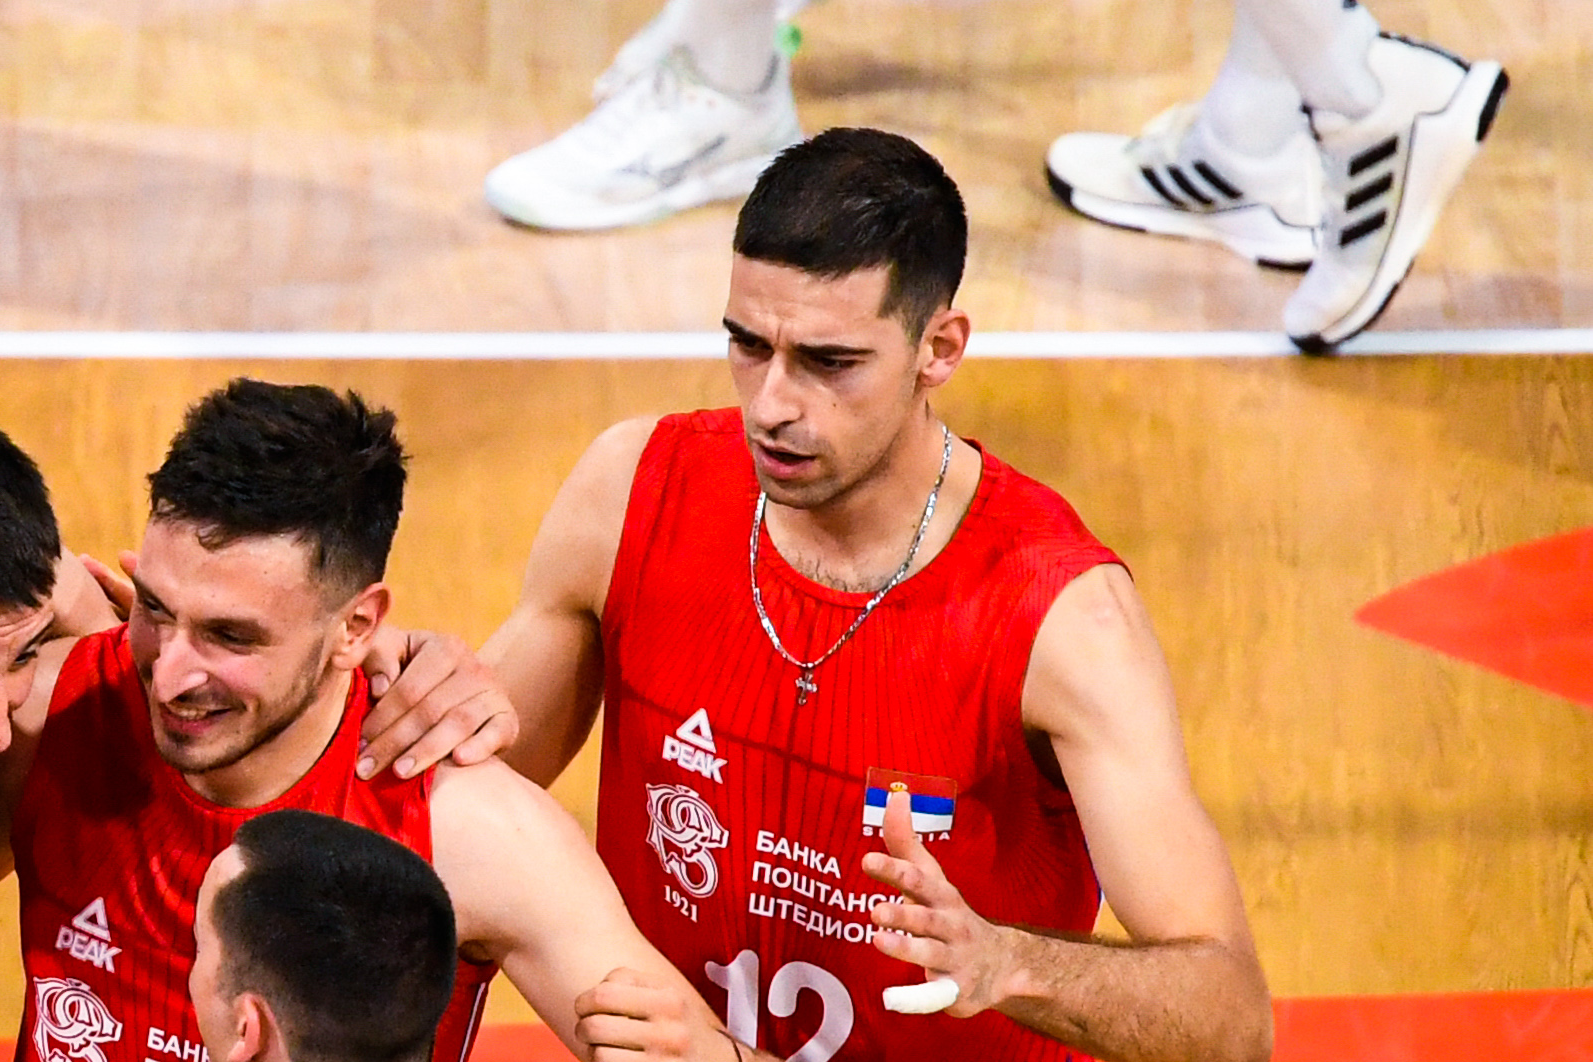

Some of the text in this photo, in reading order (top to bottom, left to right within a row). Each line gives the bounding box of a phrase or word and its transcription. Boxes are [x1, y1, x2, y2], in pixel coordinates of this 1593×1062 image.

[662, 734, 728, 784] PEAK
[756, 829, 841, 879] БАНКА
[664, 884, 698, 923] 1921
[56, 924, 122, 974] PEAK
